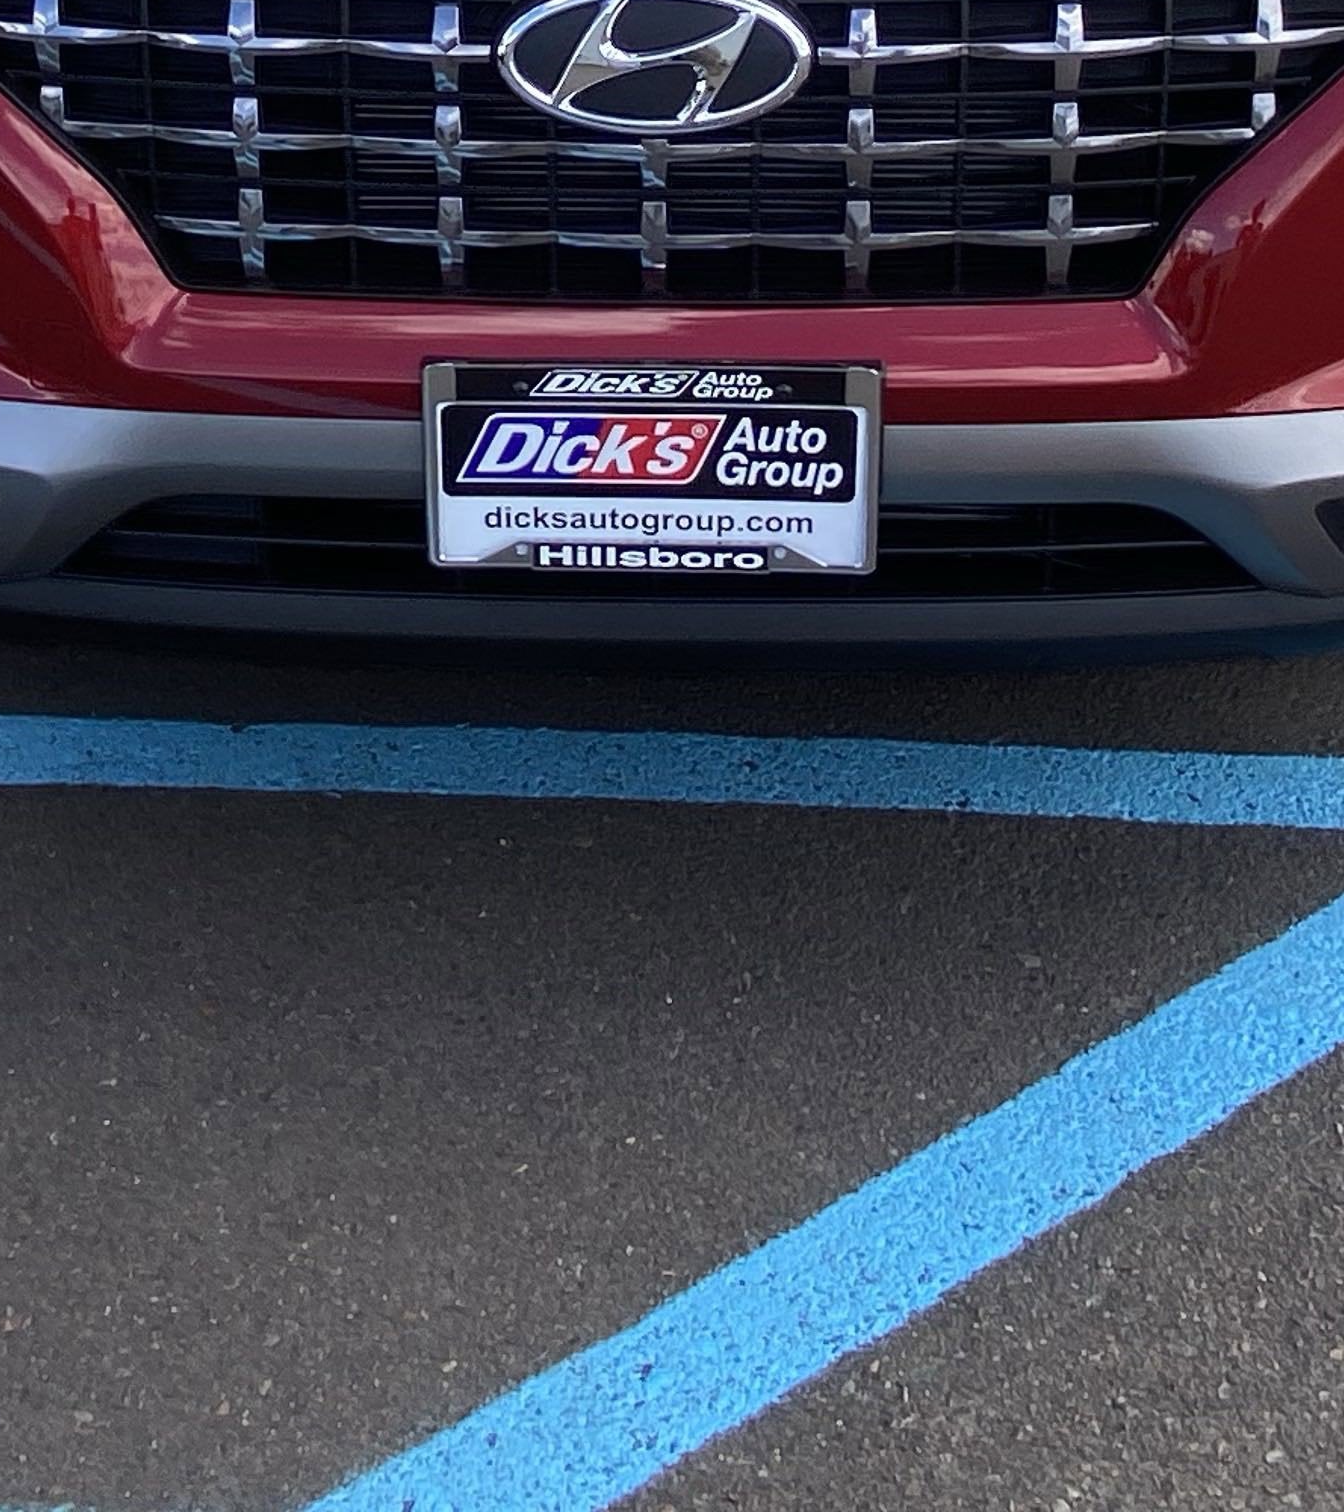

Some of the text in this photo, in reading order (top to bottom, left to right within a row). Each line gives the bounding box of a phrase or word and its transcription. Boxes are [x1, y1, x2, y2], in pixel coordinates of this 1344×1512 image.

[543, 371, 679, 394] Dick's
[693, 384, 773, 401] Group
[700, 371, 763, 387] Auto
[476, 416, 694, 475] Dick's
[723, 417, 827, 455] Auto
[716, 452, 844, 495] Group
[484, 506, 814, 536] dicksautogroup.com
[538, 545, 765, 570] Hillsboro
